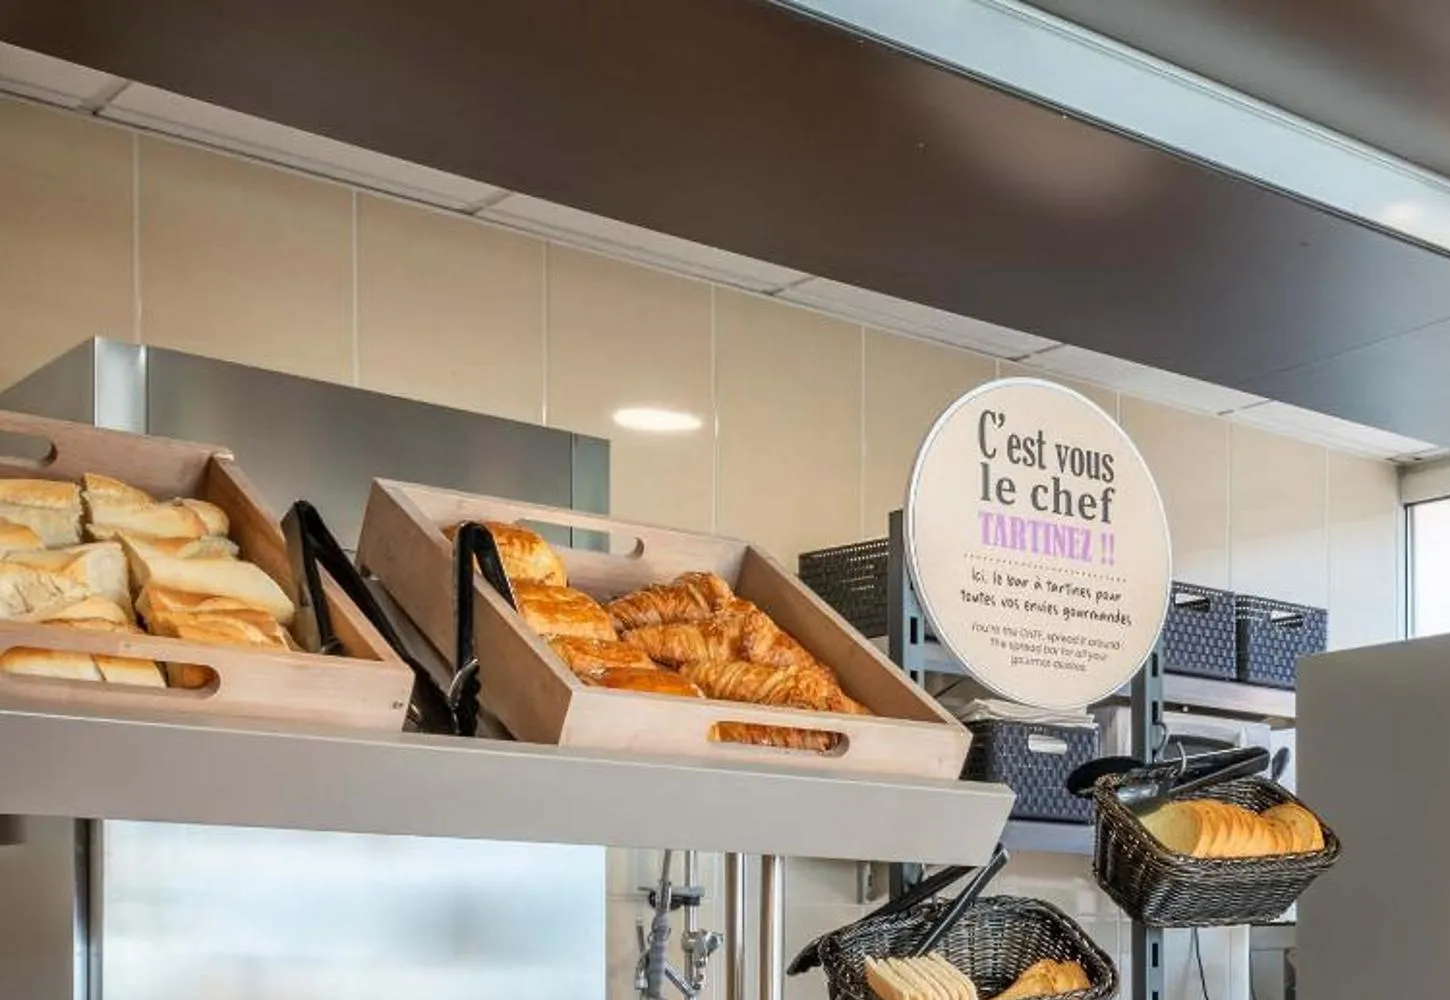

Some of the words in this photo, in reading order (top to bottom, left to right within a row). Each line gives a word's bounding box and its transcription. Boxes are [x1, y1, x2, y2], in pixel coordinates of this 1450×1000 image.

[978, 409, 1047, 470] C'est
[1055, 444, 1115, 483] vous
[979, 462, 1016, 506] le
[1030, 477, 1116, 525] chef
[978, 511, 1093, 562] TARTINEZ
